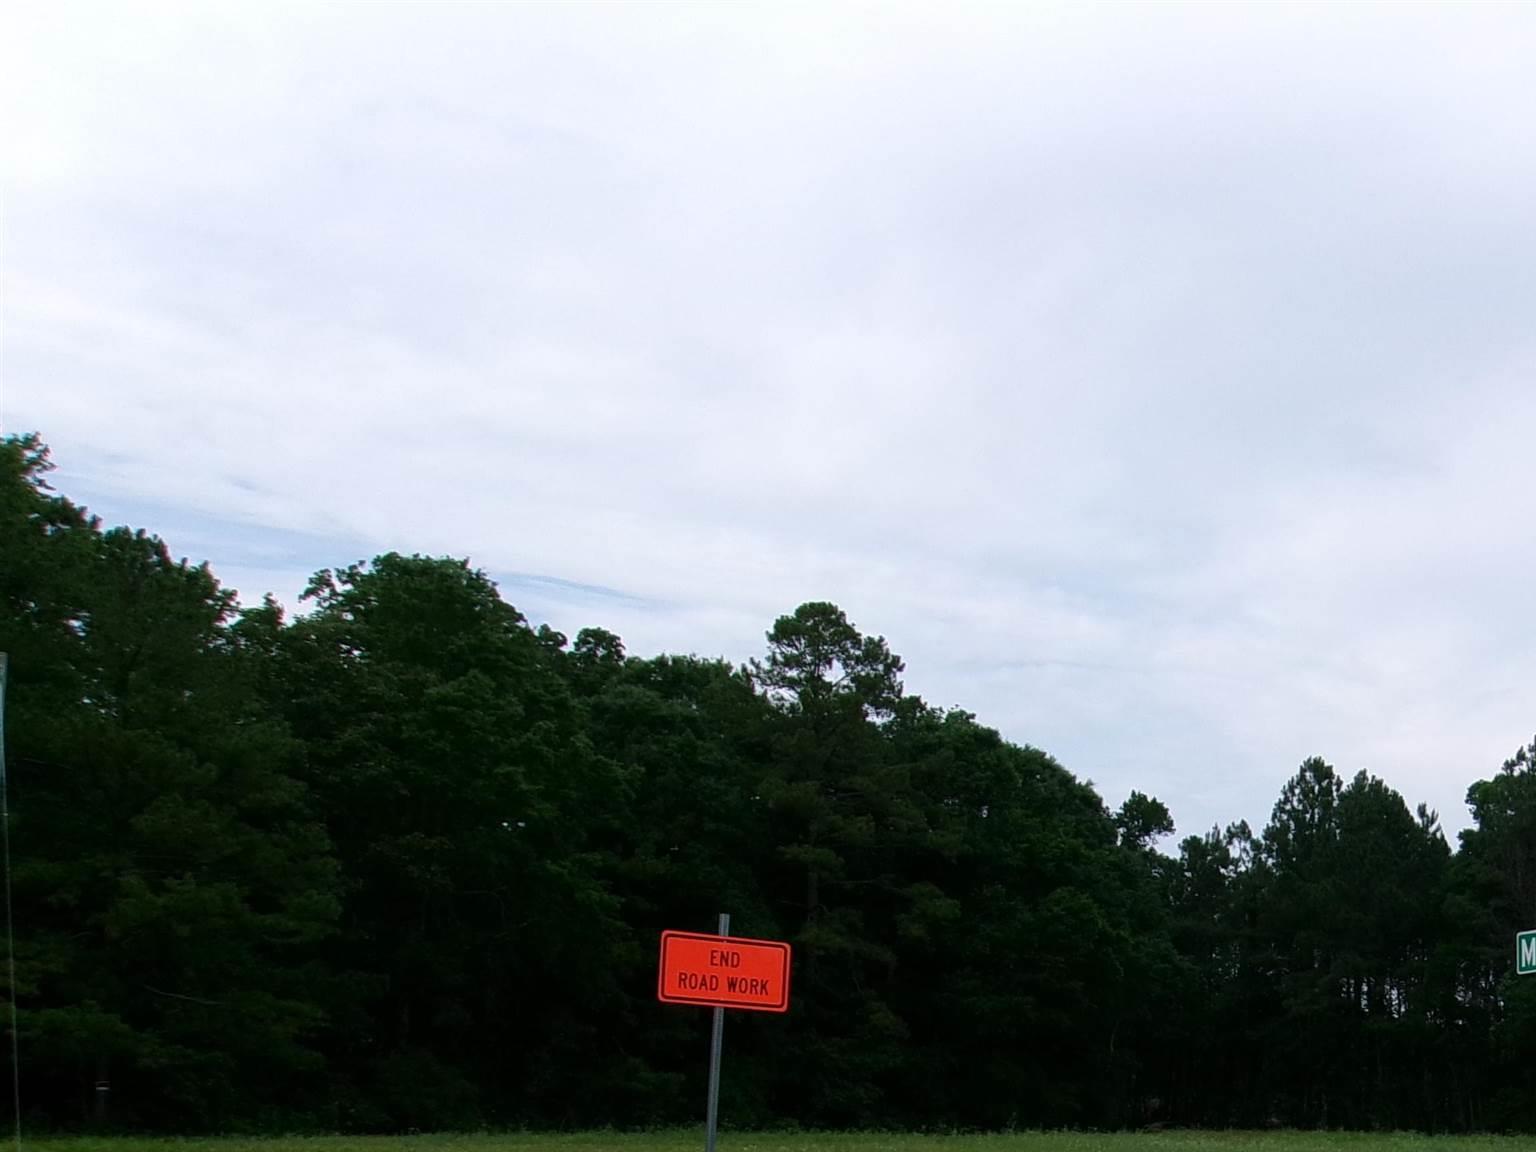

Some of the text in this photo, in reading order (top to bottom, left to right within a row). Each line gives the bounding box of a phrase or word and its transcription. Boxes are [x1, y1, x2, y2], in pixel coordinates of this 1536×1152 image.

[709, 949, 741, 969] END
[678, 971, 770, 996] ROAD WORK
